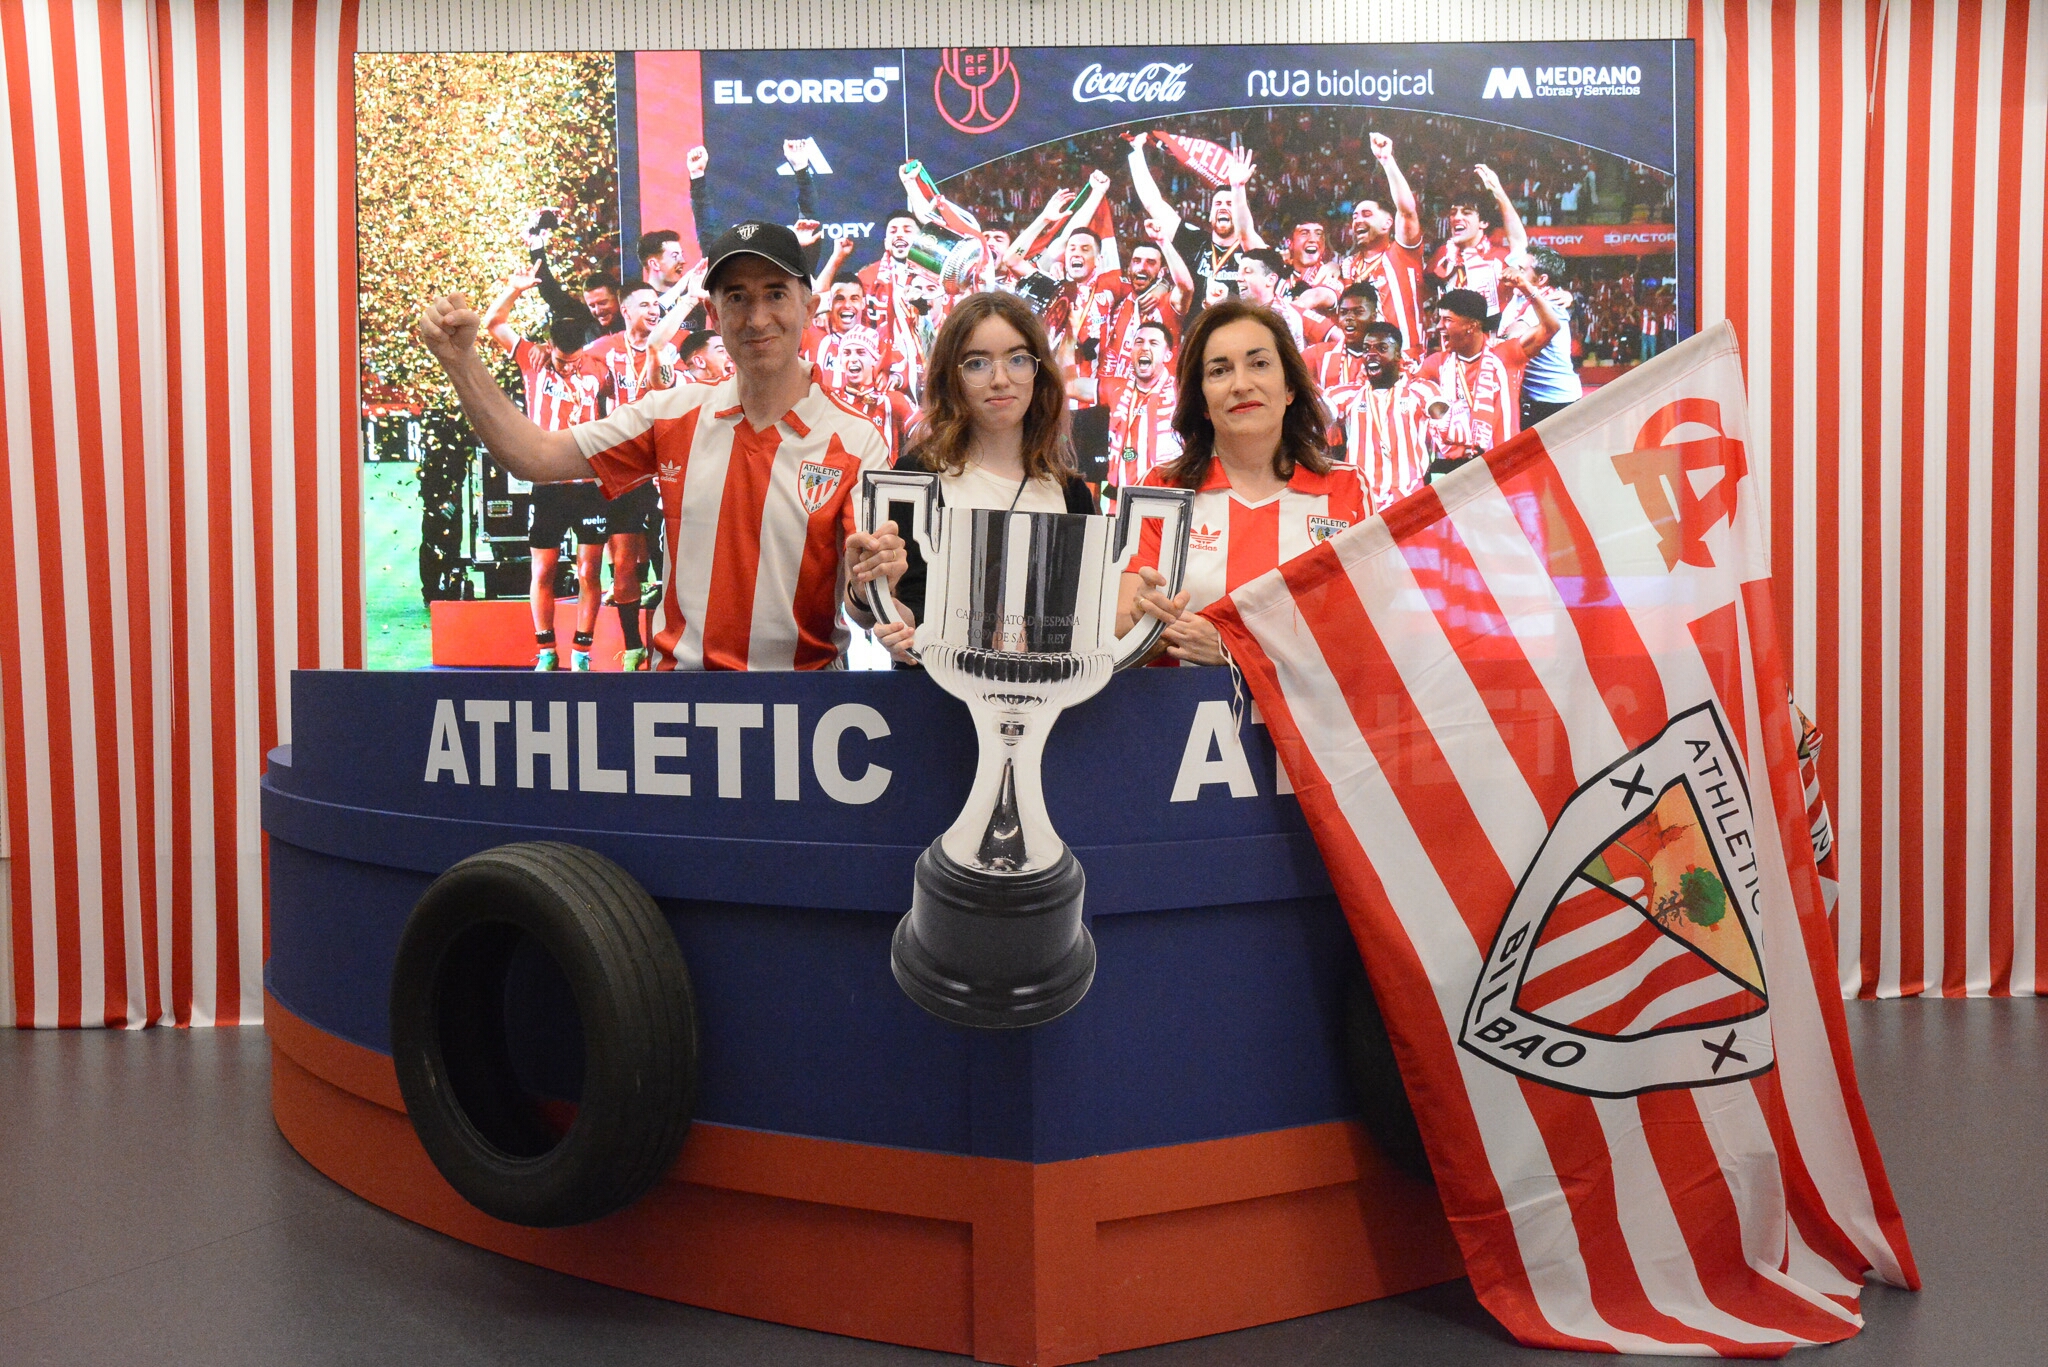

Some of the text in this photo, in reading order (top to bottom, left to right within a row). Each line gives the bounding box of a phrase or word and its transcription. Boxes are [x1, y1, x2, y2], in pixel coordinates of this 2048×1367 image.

[1072, 62, 1194, 102] Coca-Cola
[1535, 66, 1642, 85] MEDRANO
[713, 78, 889, 104] EL CORREO
[1317, 68, 1435, 101] biological
[1536, 85, 1641, 99] Obras y Servicios
[803, 464, 840, 477] ATHLETIC
[1310, 517, 1347, 528] ATHLETIC
[1189, 543, 1218, 552] adidas
[1047, 633, 1067, 644] REY
[424, 698, 893, 805] ATHLETIC
